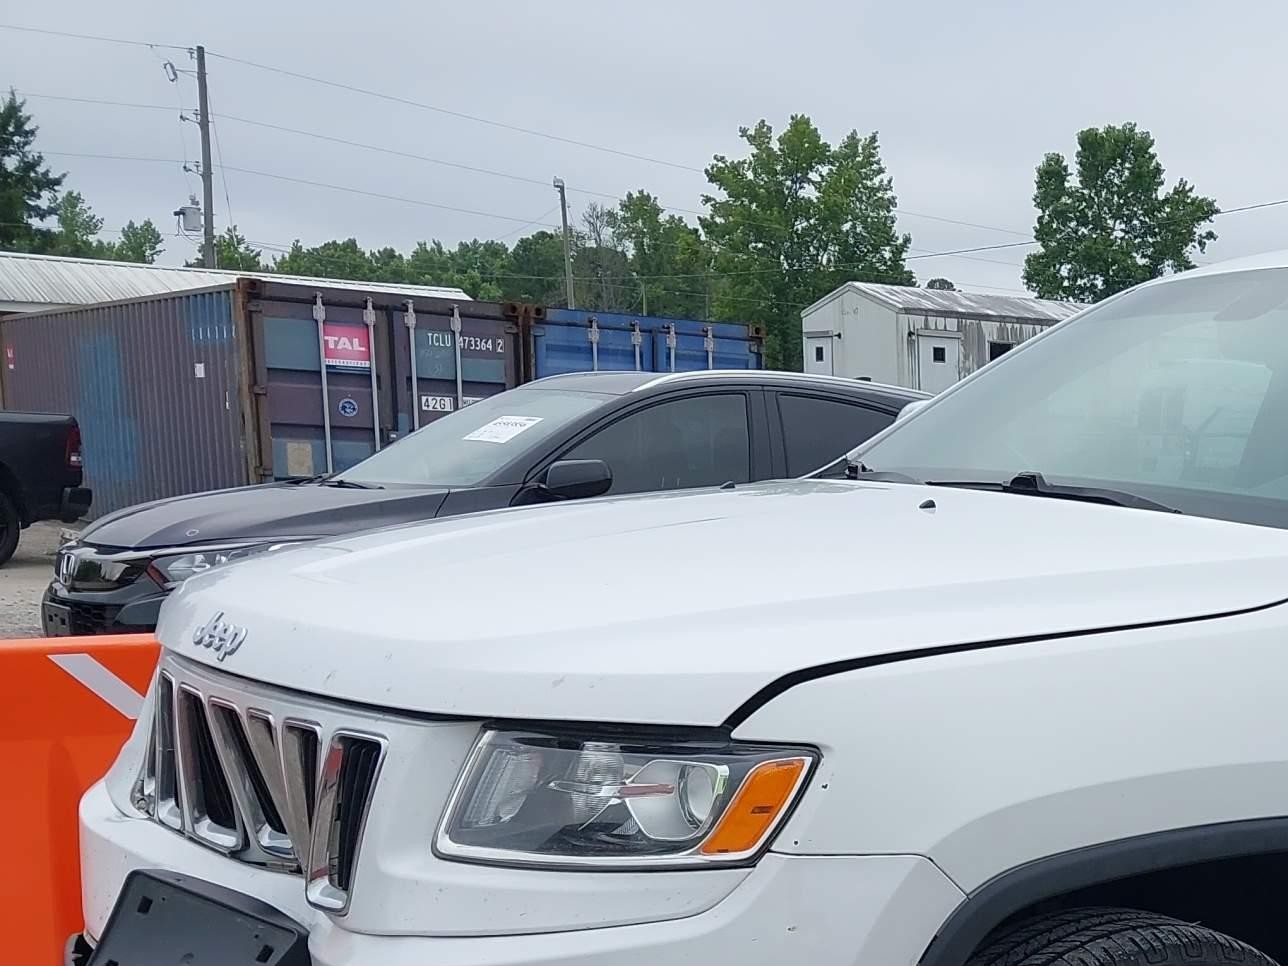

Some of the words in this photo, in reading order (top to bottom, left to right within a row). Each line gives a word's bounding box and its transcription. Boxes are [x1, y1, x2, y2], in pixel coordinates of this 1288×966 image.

[324, 336, 366, 351] TAL
[427, 333, 452, 347] TCLU
[496, 339, 504, 352] 2
[423, 398, 454, 410] 42G1
[192, 610, 248, 662] Jeep
